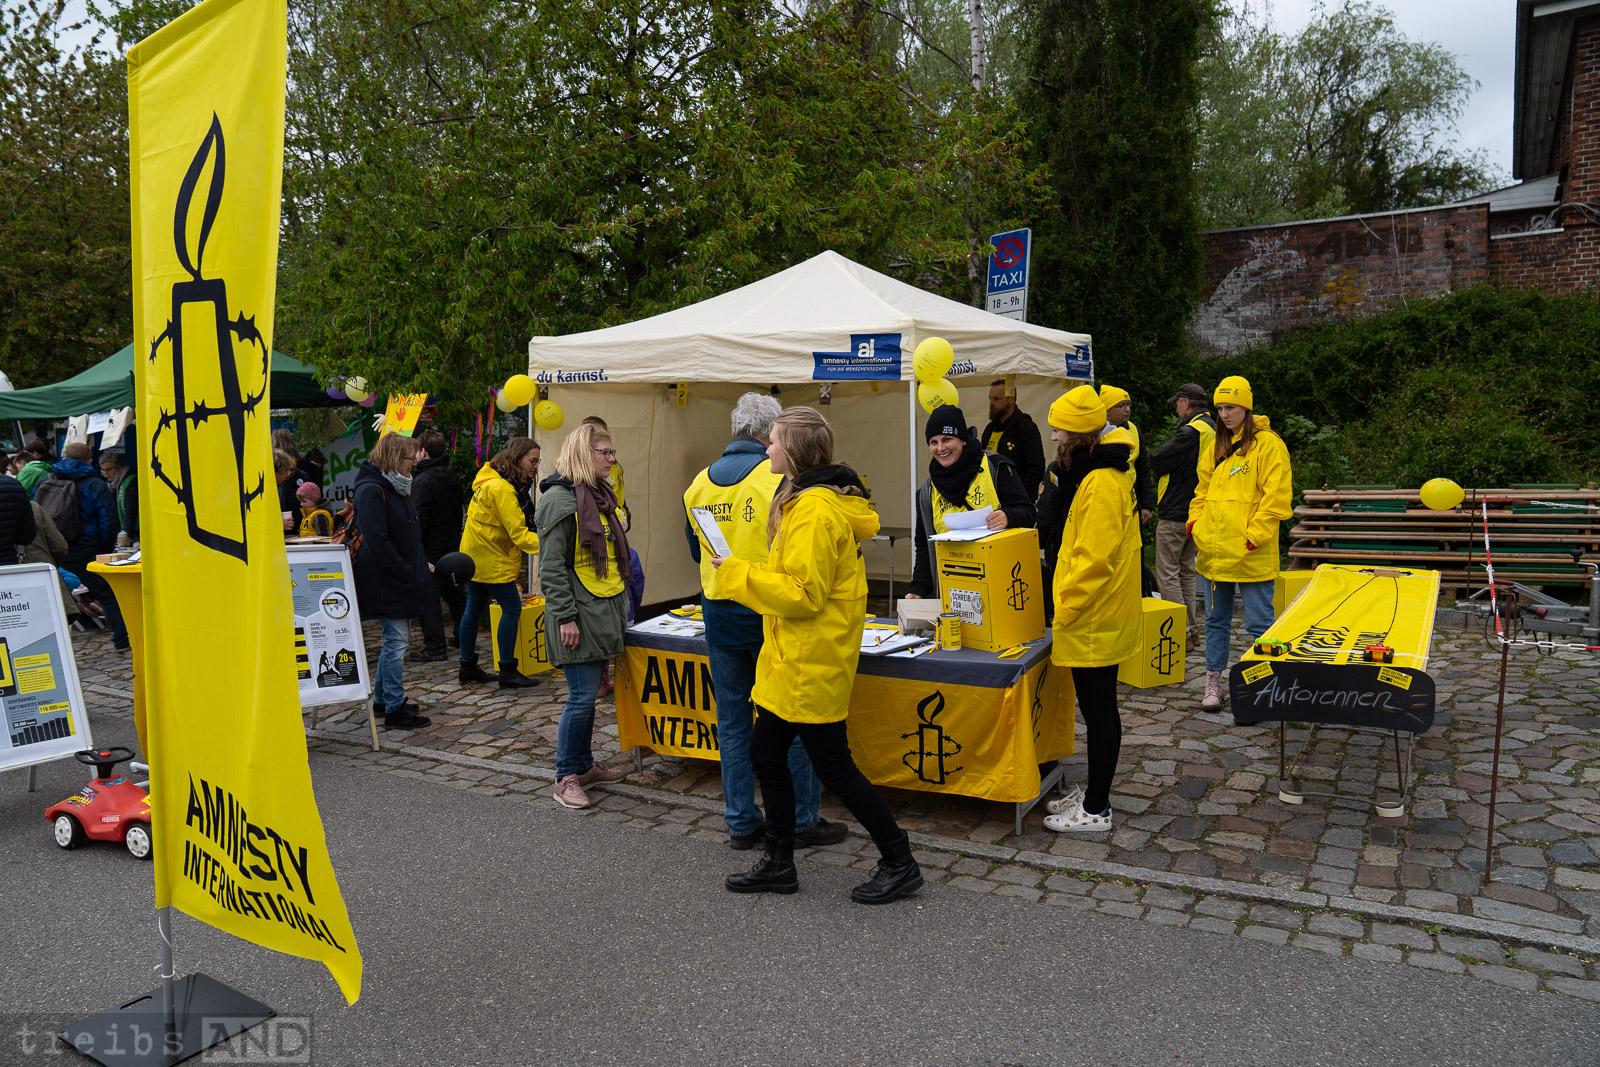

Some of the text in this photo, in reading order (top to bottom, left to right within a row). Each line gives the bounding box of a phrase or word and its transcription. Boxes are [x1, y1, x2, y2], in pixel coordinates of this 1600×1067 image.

[992, 271, 1022, 287] TAXI
[992, 299, 1001, 309] 18
[1010, 296, 1020, 306] 9h
[851, 356, 893, 364] international
[945, 359, 978, 376] annst.
[536, 368, 609, 383] du kannst.
[952, 593, 972, 602] SCHREIB
[952, 600, 962, 609] FÜR
[0, 601, 30, 613] handel
[338, 653, 349, 663] 20
[641, 655, 717, 711] AMN
[1253, 676, 1402, 711] Autorennen
[186, 771, 316, 906] AMNESTY
[183, 840, 347, 953] INTERNATIONAL
